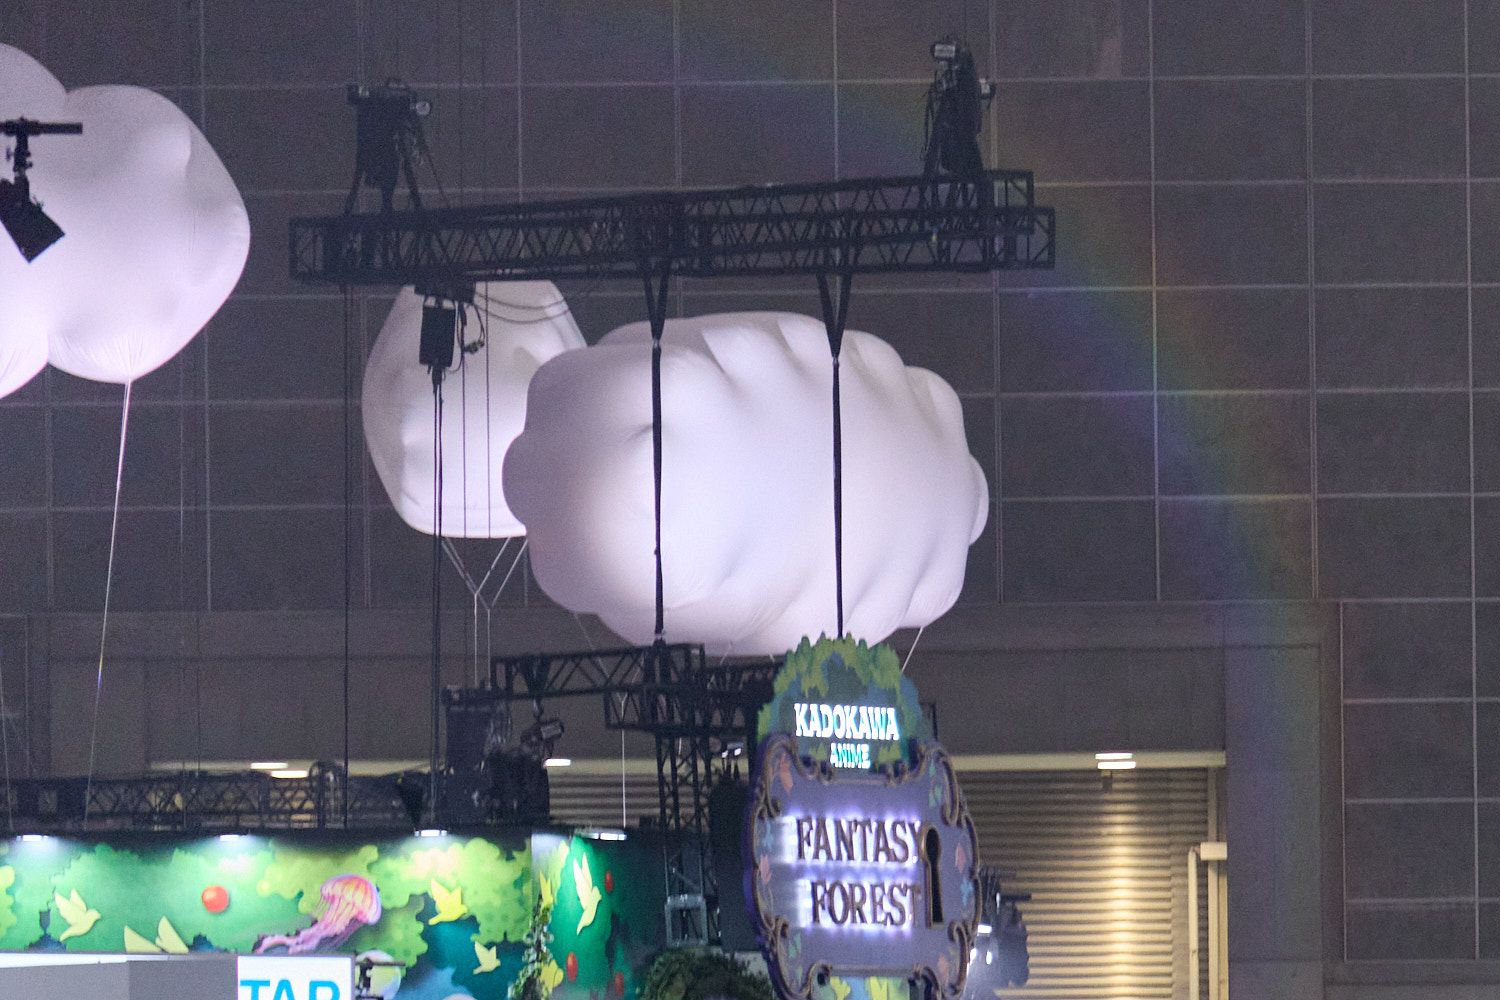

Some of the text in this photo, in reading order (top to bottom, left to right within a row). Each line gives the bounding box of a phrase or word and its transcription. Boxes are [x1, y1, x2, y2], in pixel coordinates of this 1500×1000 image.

[794, 703, 900, 740] KADOKAWA
[830, 742, 871, 769] ANIME
[797, 815, 921, 864] FANTASY
[811, 879, 921, 926] FOREST
